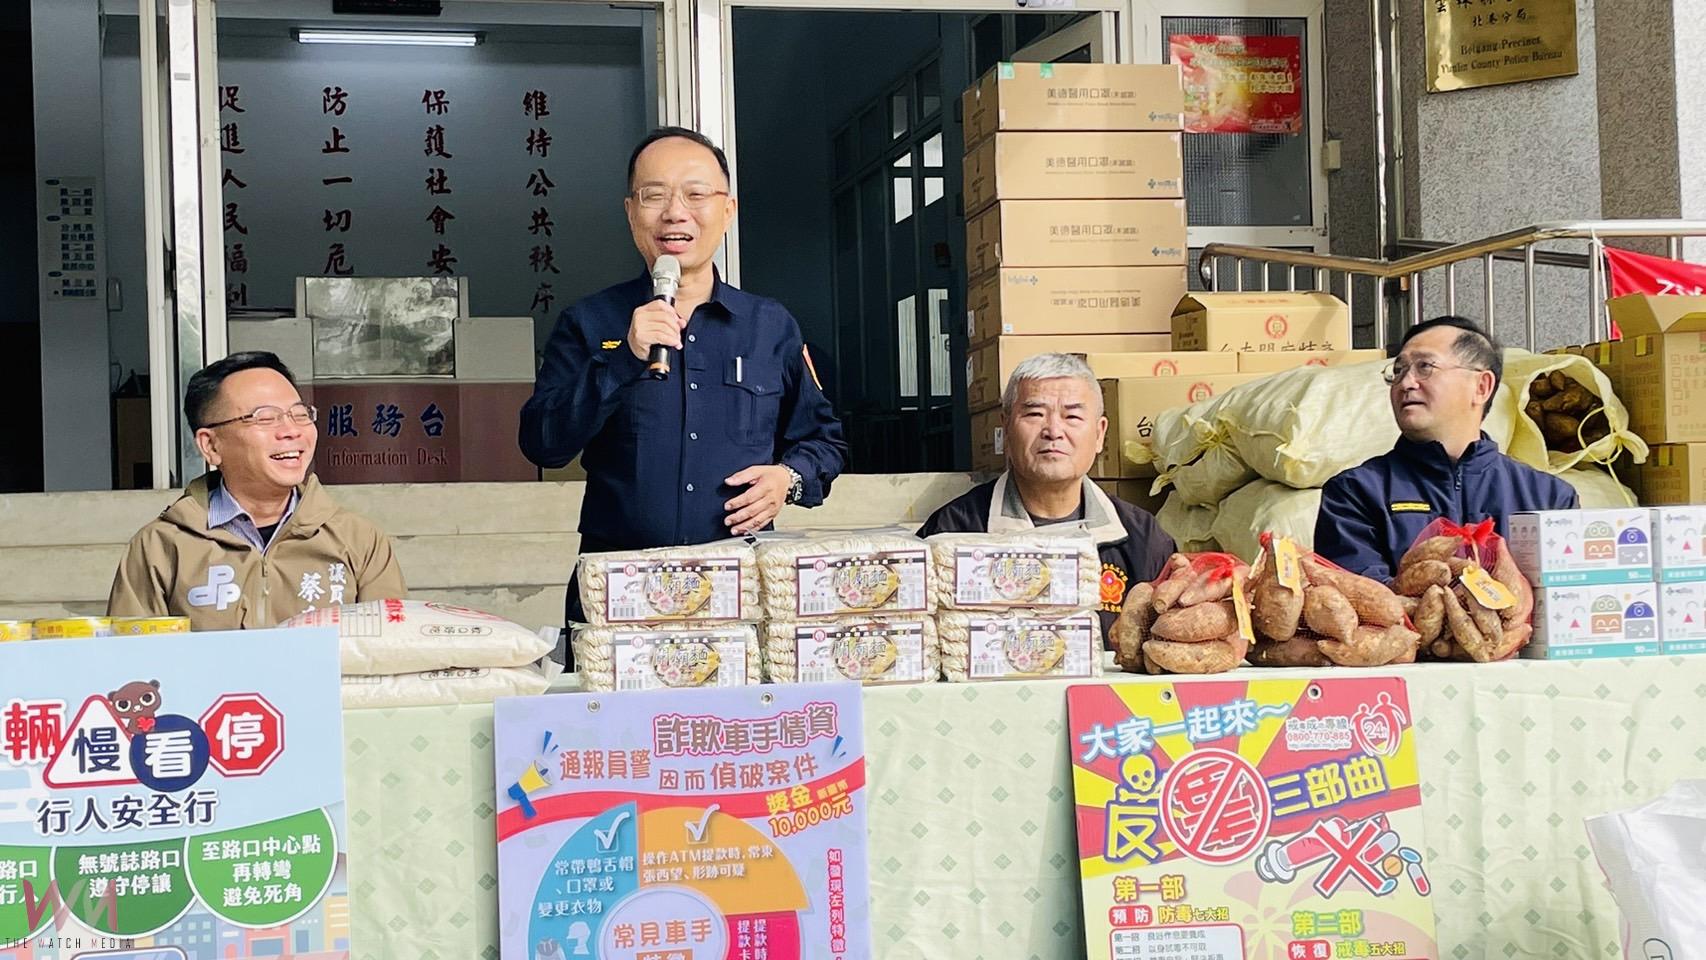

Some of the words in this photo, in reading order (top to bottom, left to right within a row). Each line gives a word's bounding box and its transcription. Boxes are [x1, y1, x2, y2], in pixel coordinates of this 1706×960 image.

[1471, 8, 1527, 27] 北港分局
[1471, 60, 1500, 71] County
[1503, 54, 1530, 66] Police
[523, 90, 560, 313] 維持公共秩序
[327, 403, 444, 437] 服務台
[327, 448, 408, 466] Information
[417, 448, 448, 465] Desk
[656, 705, 835, 753] 詐欺車手情資
[1287, 730, 1350, 741] 0800-770-885
[560, 750, 651, 780] 通報員警
[659, 755, 819, 791] 因而偵破案件
[38, 790, 218, 834] 行人安全行
[766, 785, 812, 815] 獎金
[769, 794, 853, 838] 10,000元
[202, 835, 321, 861] 至路口中心點
[78, 851, 180, 875] 無號誌路口
[232, 861, 291, 883] 再轉彎
[89, 874, 172, 898] 遵守停讓
[223, 883, 302, 907] 避免死角
[1113, 876, 1184, 902] 第一部
[538, 900, 602, 918] 變更衣物
[1112, 909, 1149, 923] 預防
[1158, 905, 1229, 924] 防毒七大招
[613, 918, 712, 949] 常見車手
[1292, 912, 1364, 937] 第二部
[1291, 944, 1328, 959] 恢復
[1336, 942, 1406, 959] 戒毒五大招
